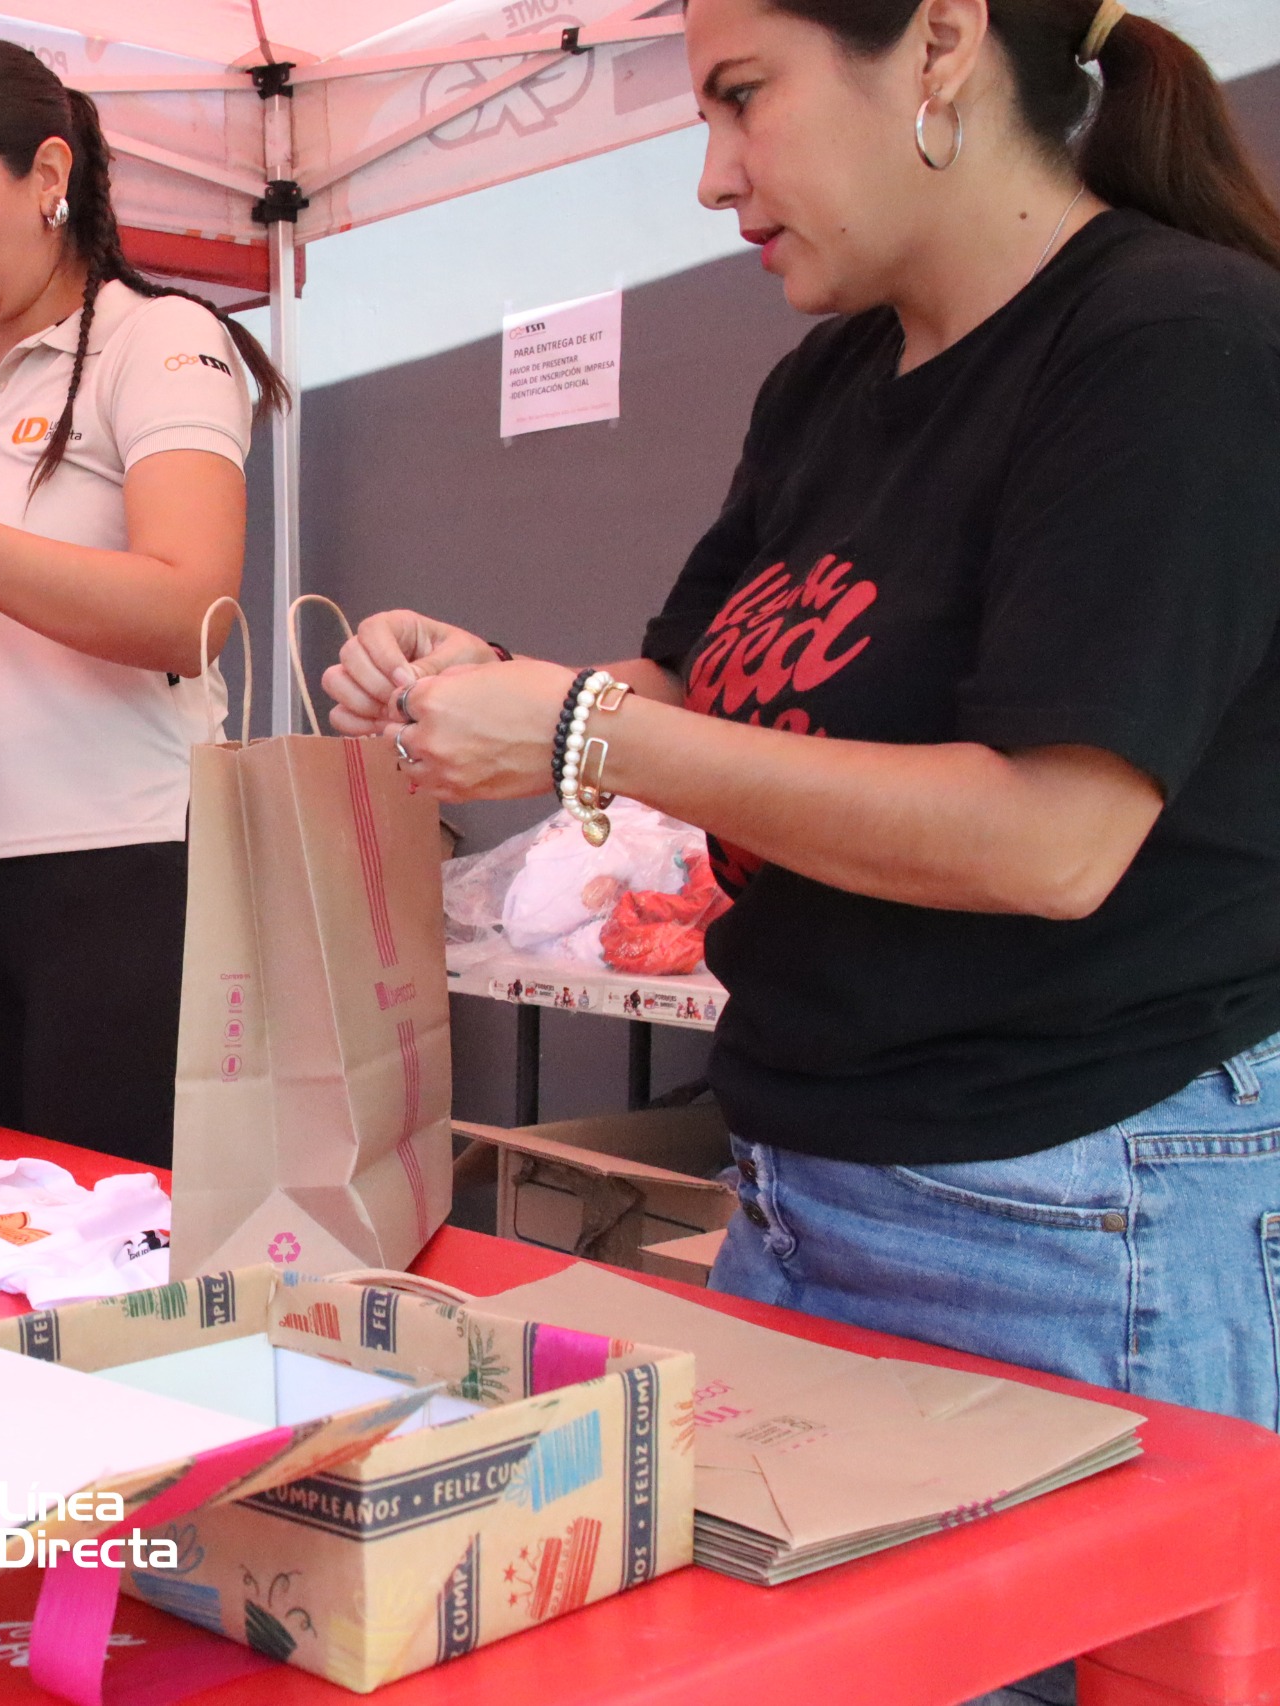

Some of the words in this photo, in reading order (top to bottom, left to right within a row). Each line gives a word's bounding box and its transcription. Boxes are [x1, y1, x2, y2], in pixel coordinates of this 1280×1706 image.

[513, 345, 535, 359] PARA
[536, 337, 574, 354] ENTREGA
[576, 334, 588, 345] DE
[589, 330, 603, 342] KIT
[509, 365, 531, 376] FAVOR
[531, 362, 541, 372] DE
[542, 354, 579, 370] PRESENTAR
[529, 376, 538, 385] DE
[539, 366, 582, 382] INSCRIPCIÓN
[584, 360, 615, 373] IMPRESA
[564, 378, 590, 391] OFICIAL
